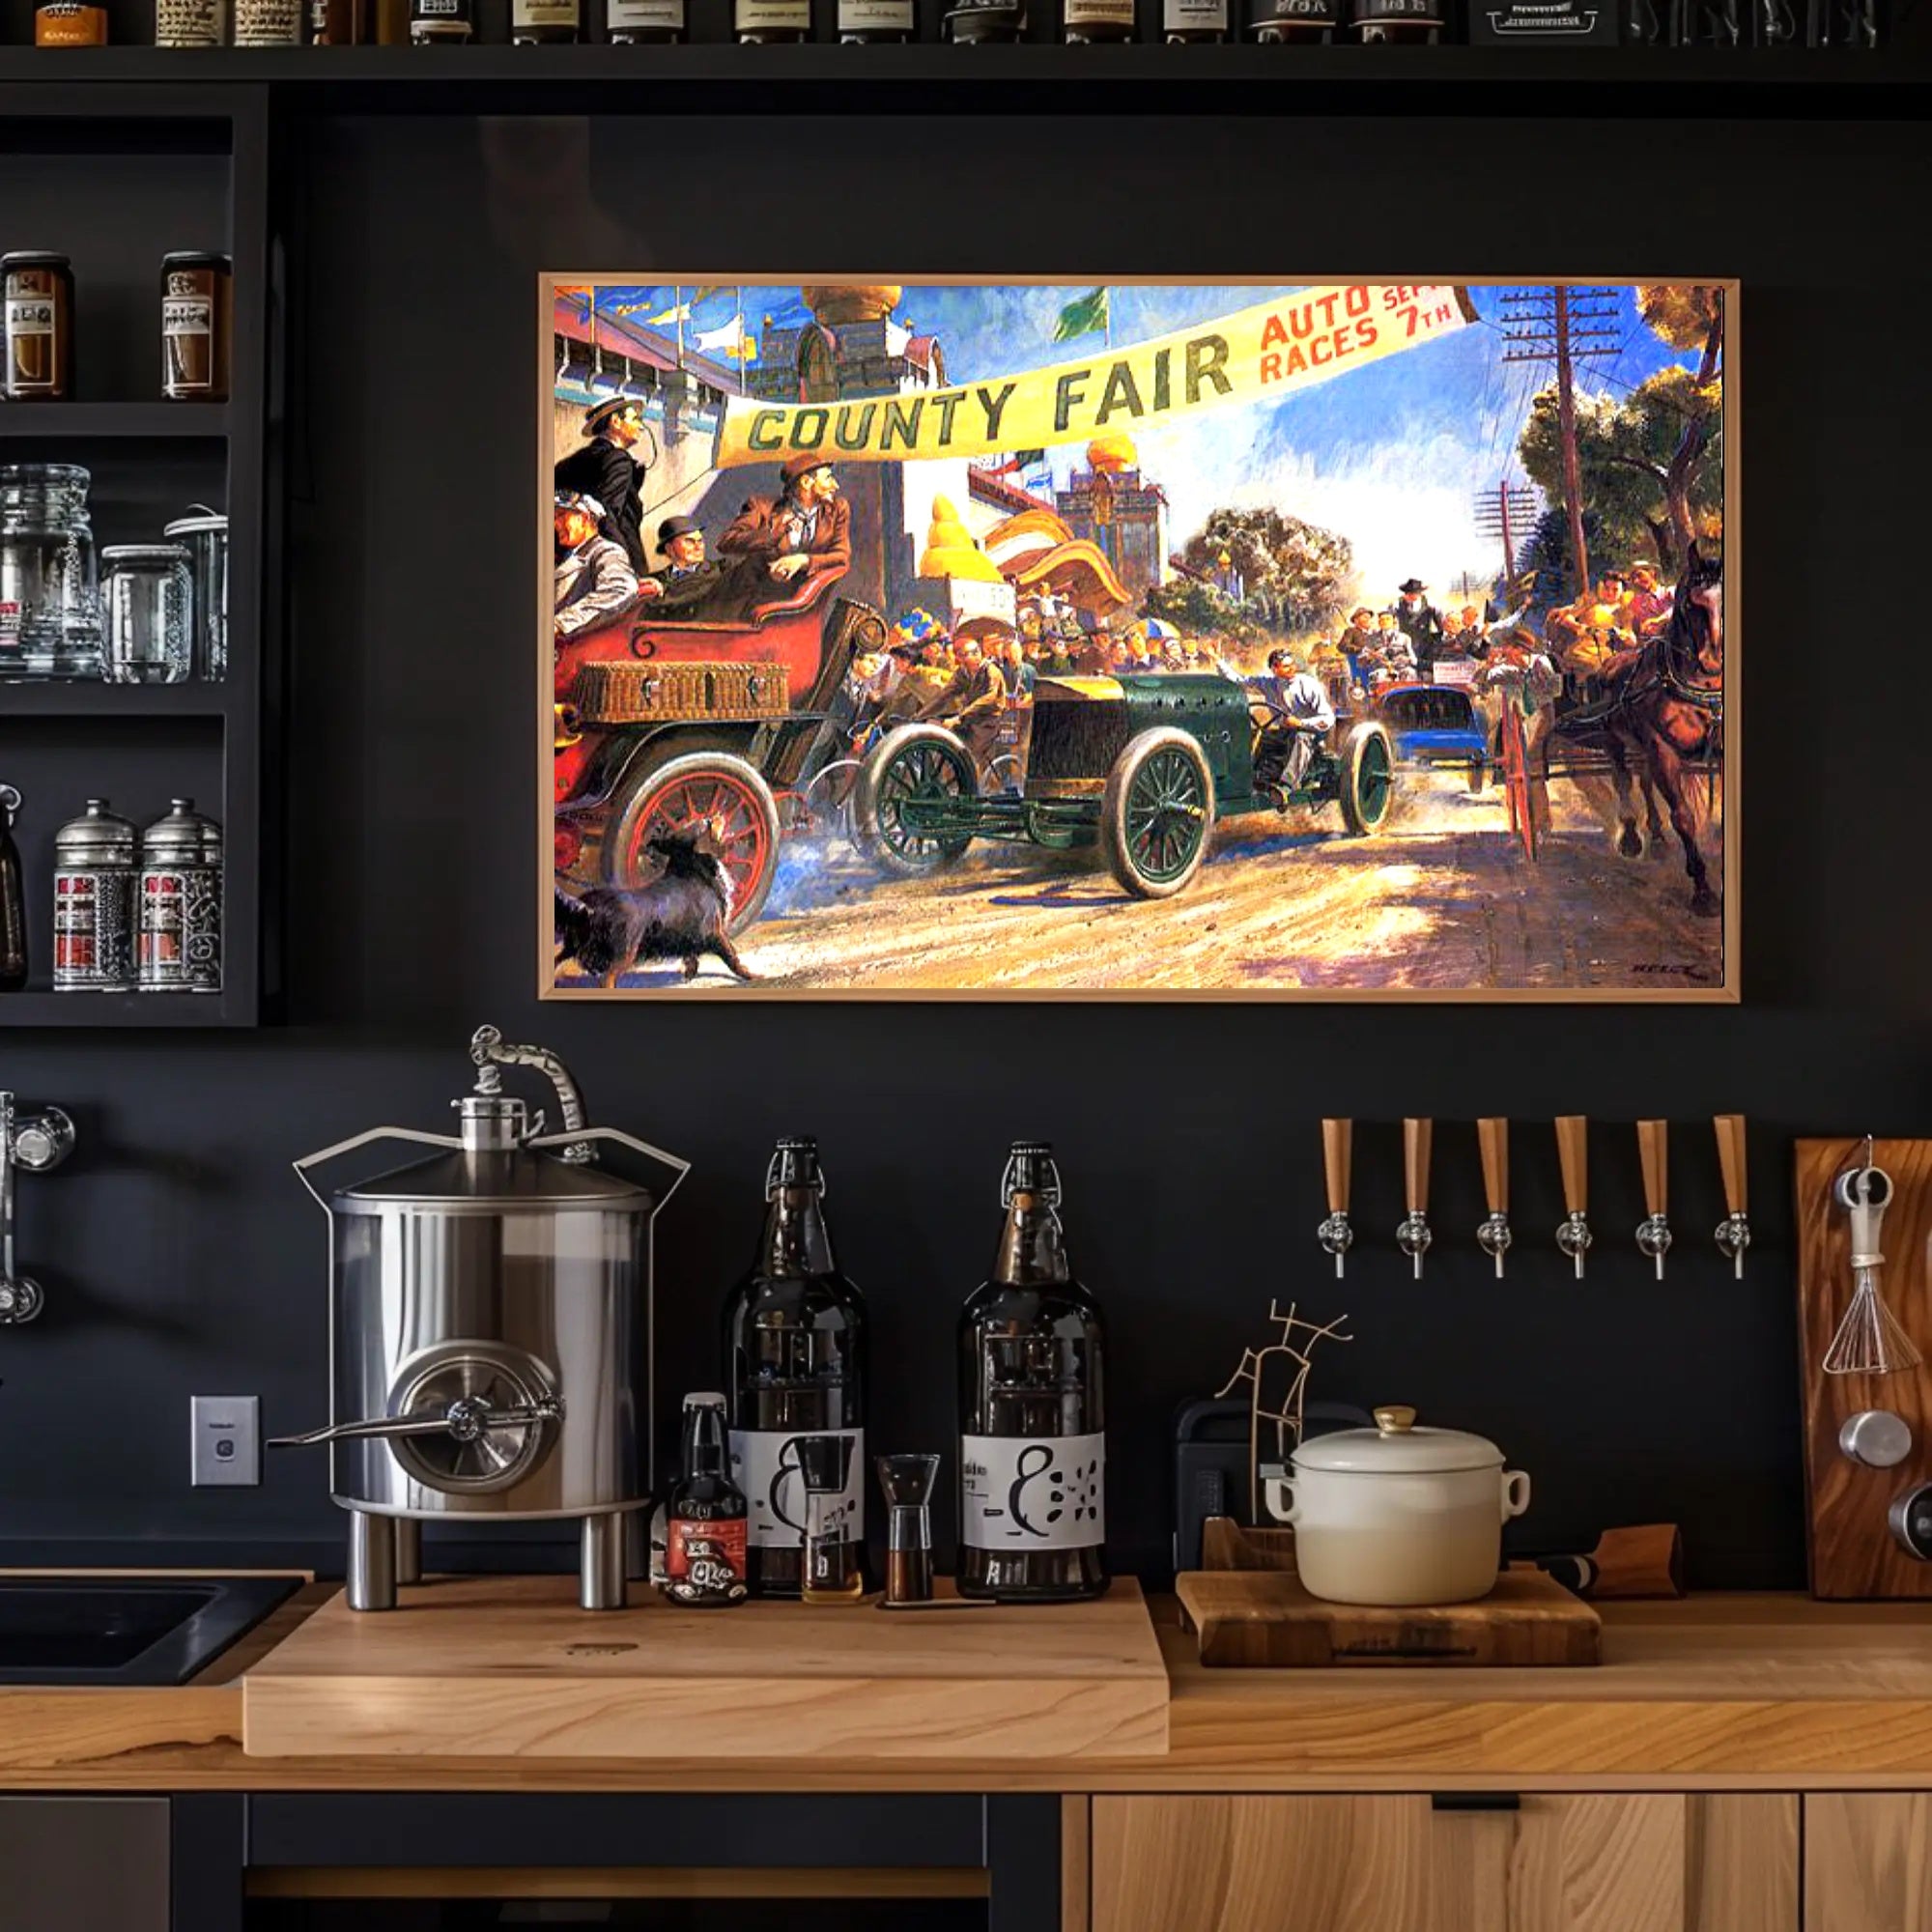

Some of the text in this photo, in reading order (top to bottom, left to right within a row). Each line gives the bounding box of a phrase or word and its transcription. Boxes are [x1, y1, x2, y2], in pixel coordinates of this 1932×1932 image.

[1261, 286, 1370, 352] AUTO
[1261, 317, 1378, 384] RACES
[1396, 304, 1451, 337] 7TH
[747, 333, 1234, 452] COUNTY FAIR
